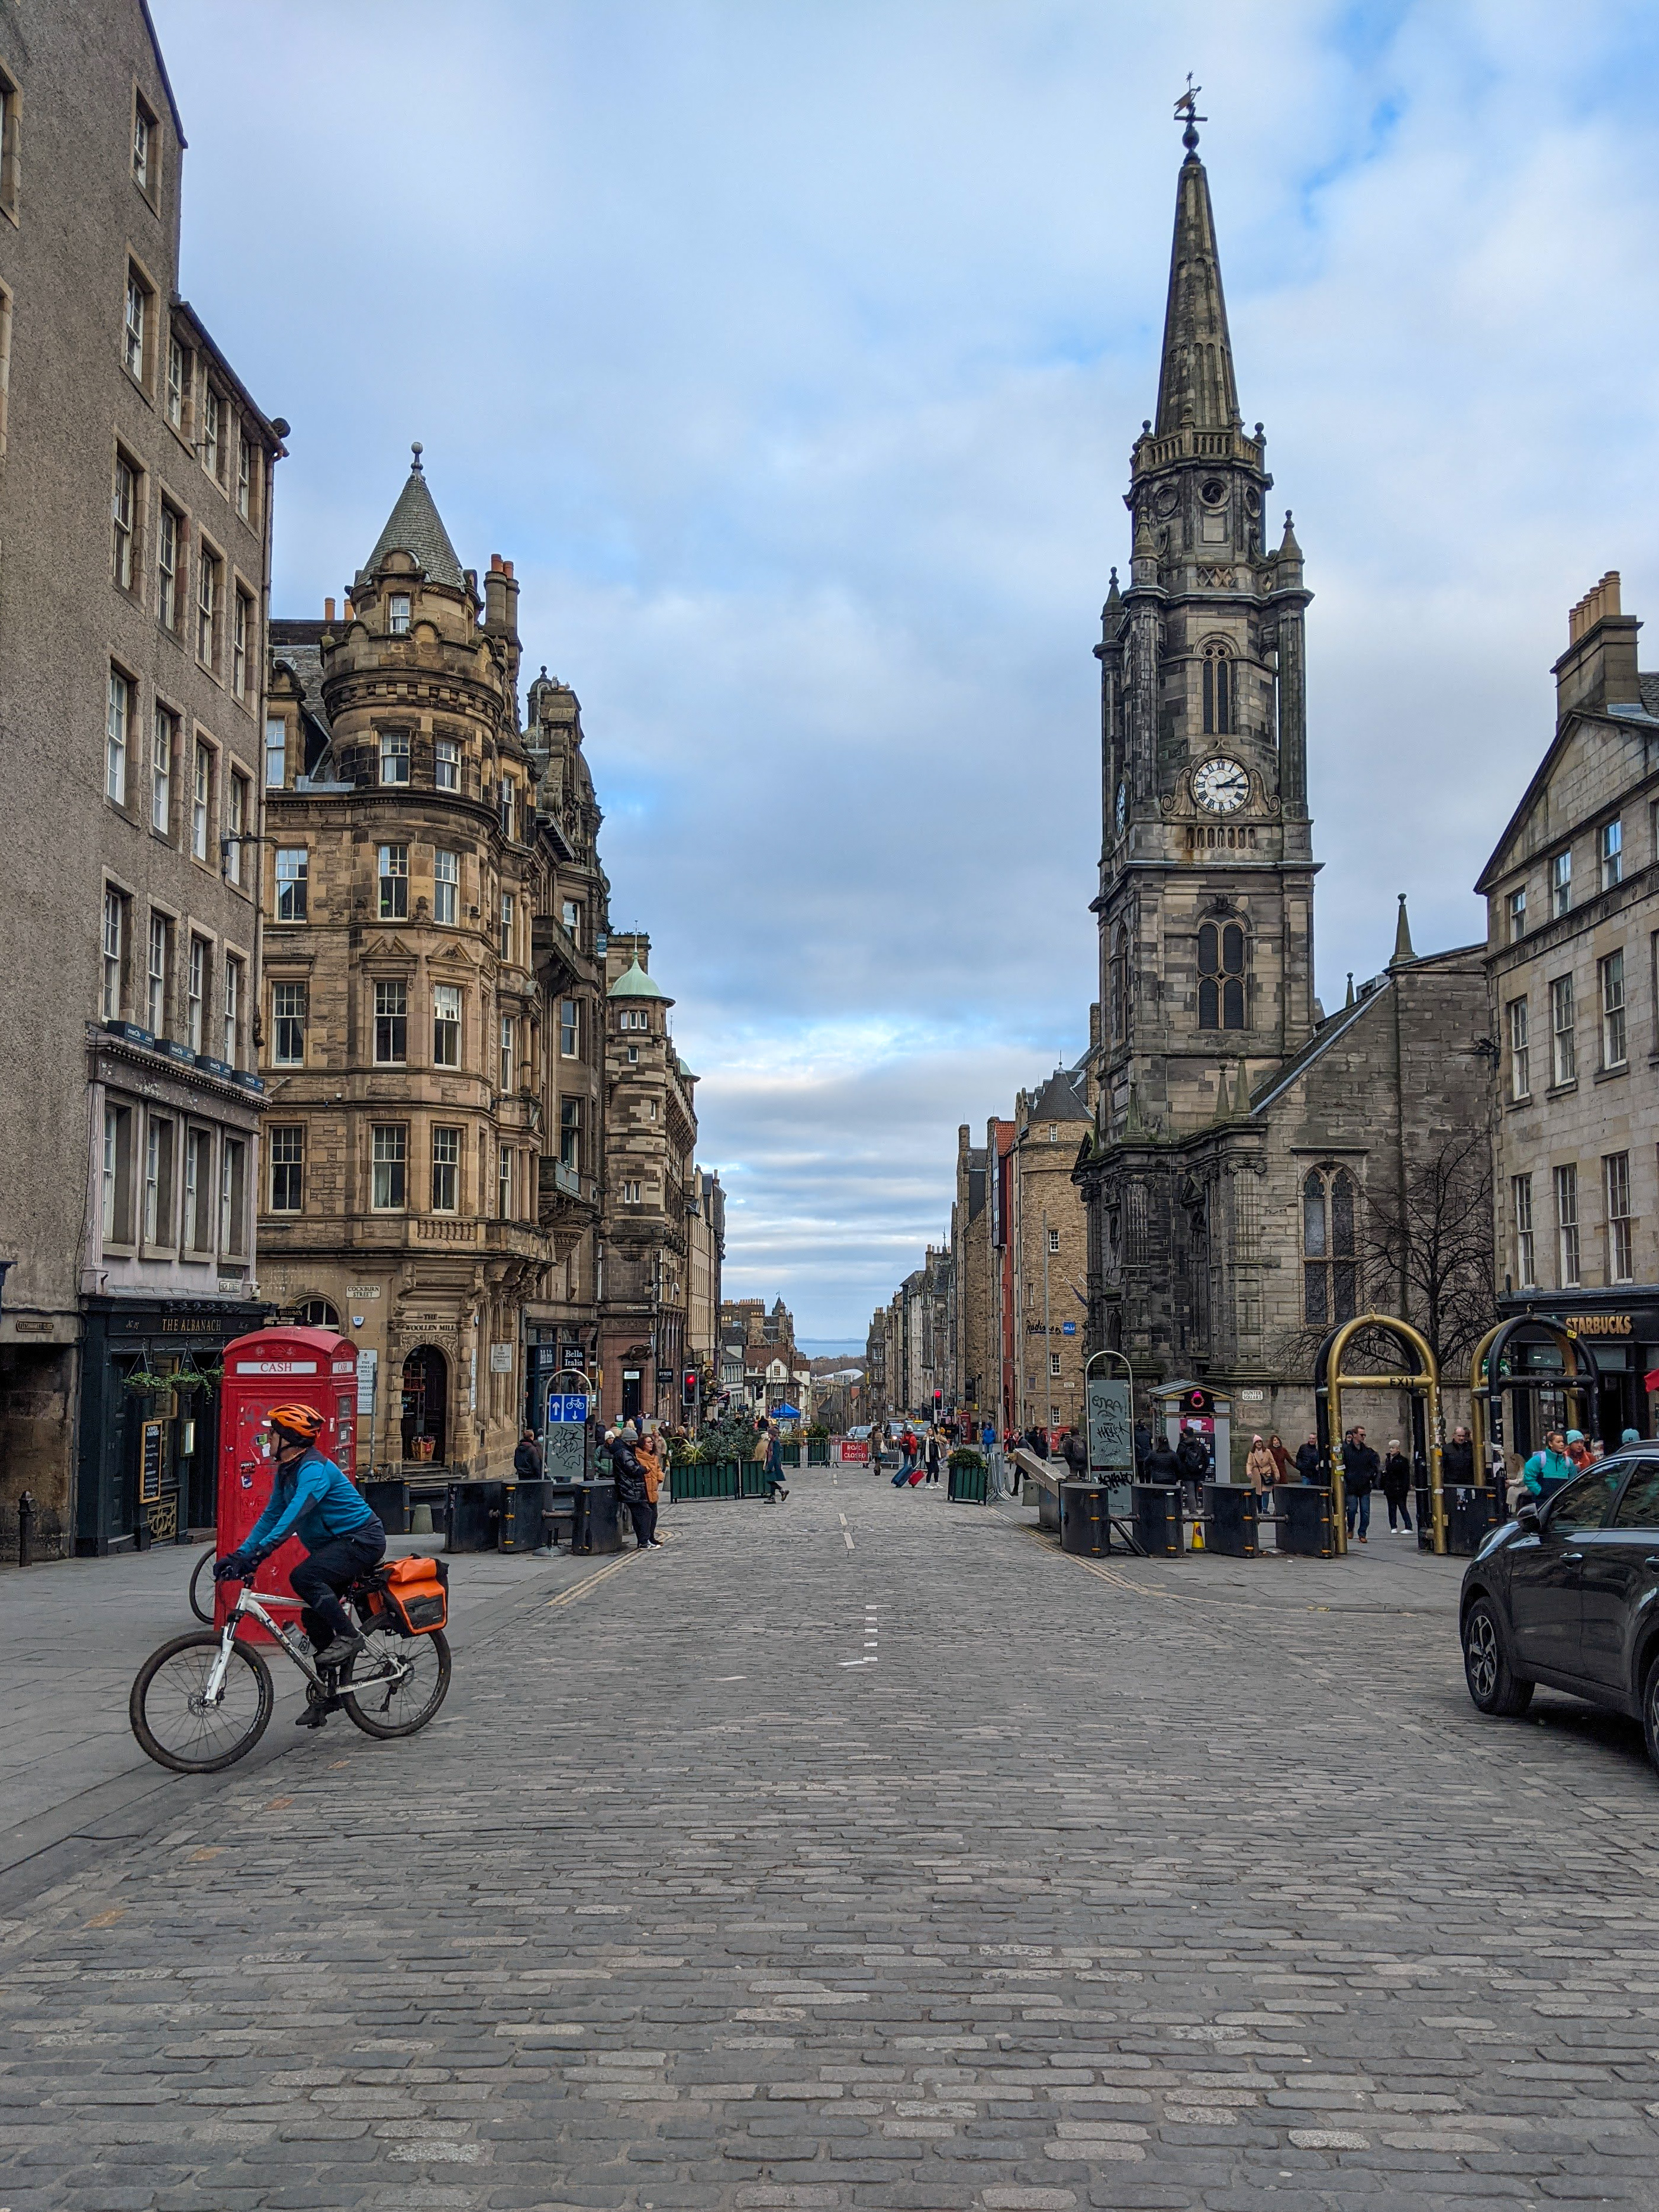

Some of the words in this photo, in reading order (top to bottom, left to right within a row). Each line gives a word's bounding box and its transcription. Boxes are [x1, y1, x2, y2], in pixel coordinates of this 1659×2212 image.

[163, 1319, 178, 1331] THE
[181, 1319, 221, 1331] ALBANACH
[1025, 1319, 1062, 1335] Radison
[1565, 1316, 1632, 1334] STARBUCKS
[260, 1363, 292, 1372] CASH
[338, 1363, 347, 1372] CASH
[1390, 1378, 1416, 1386] EXIT
